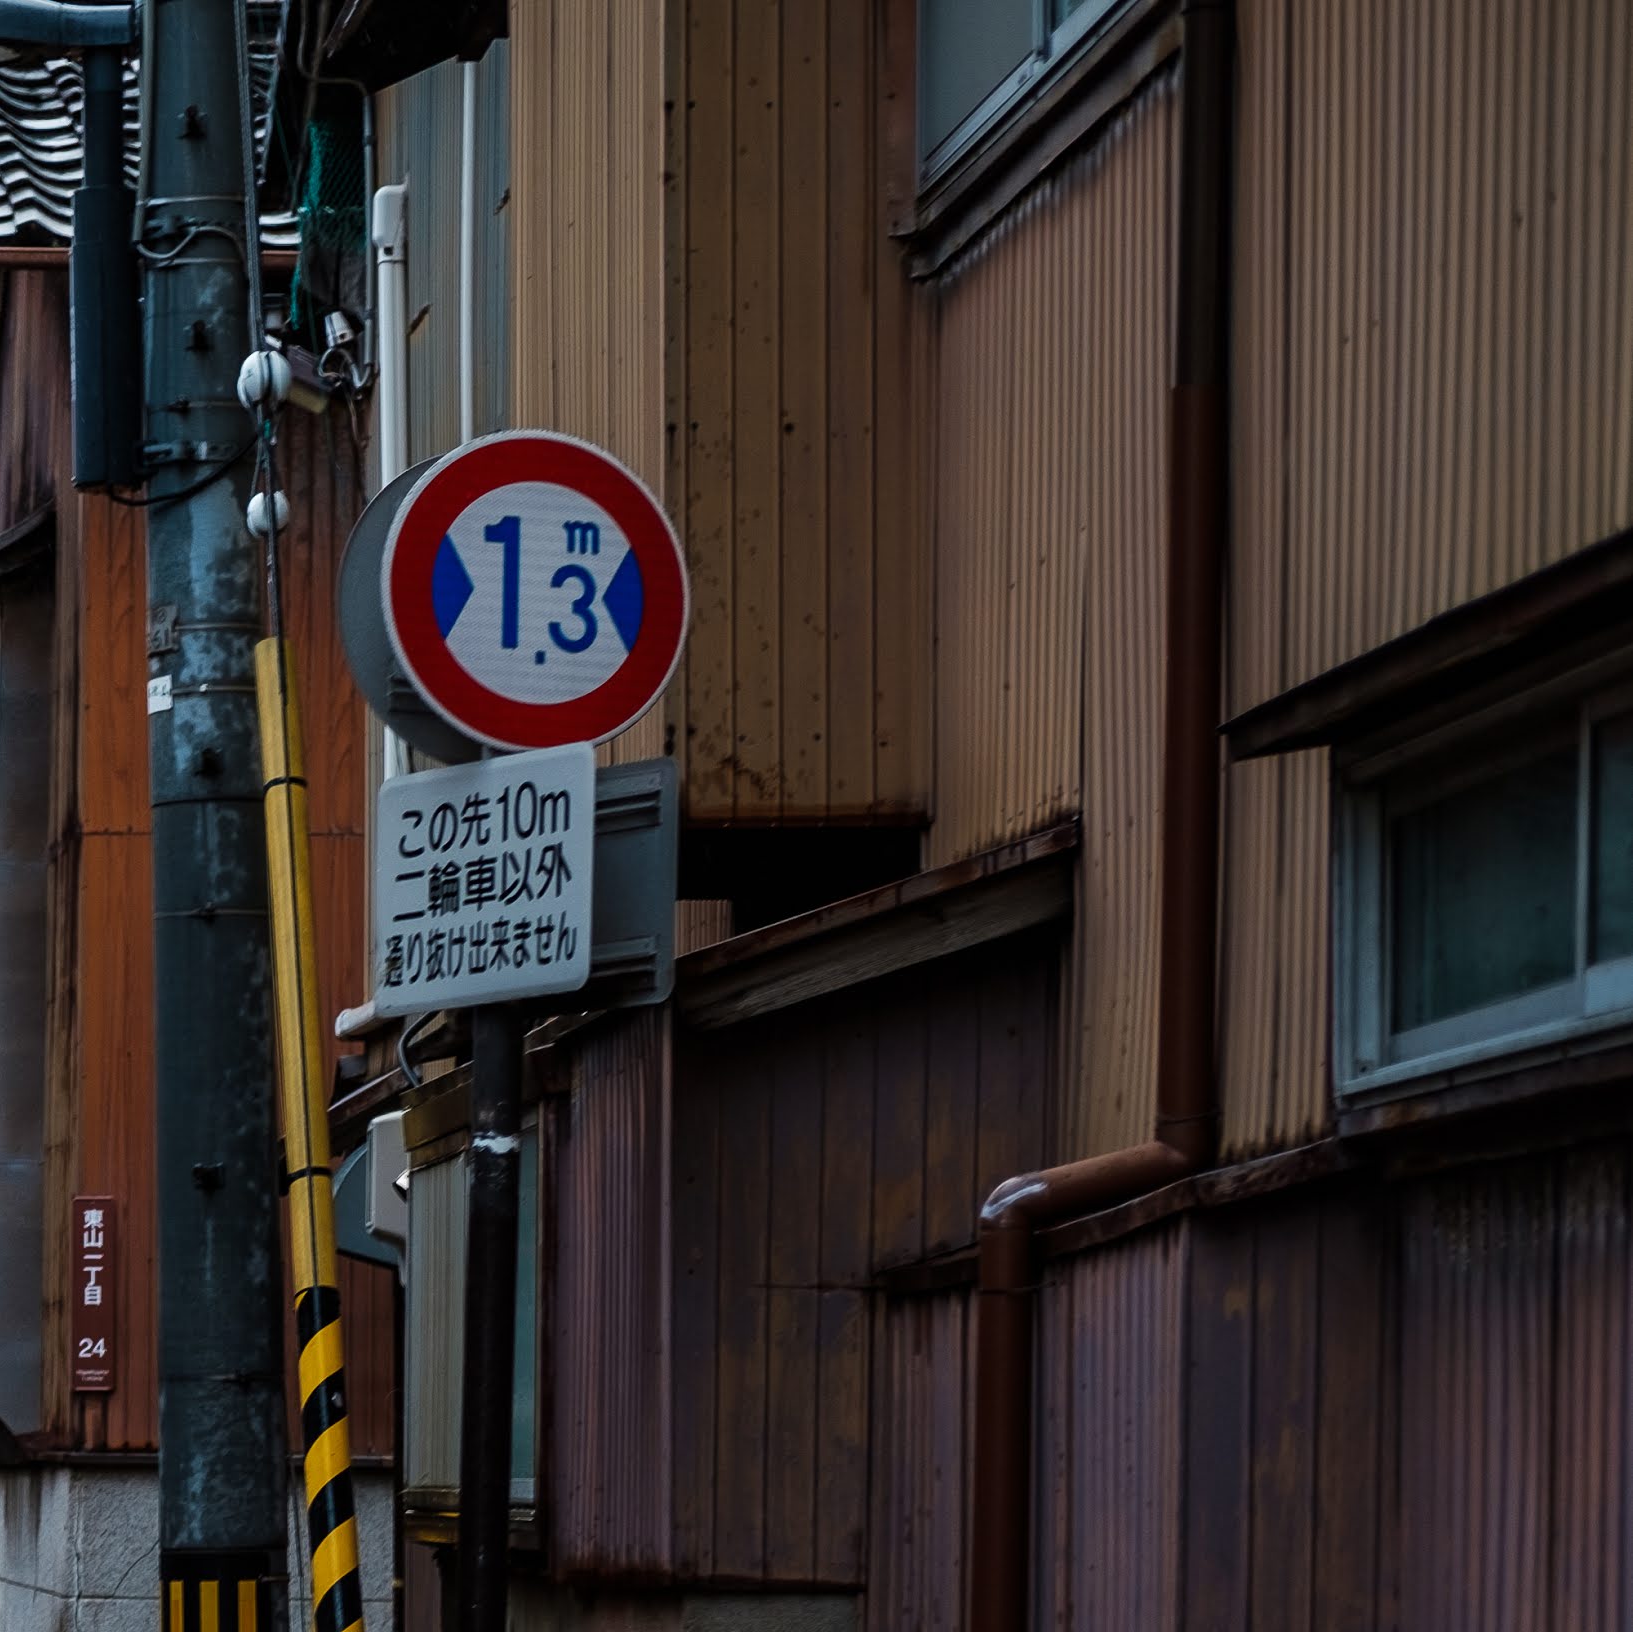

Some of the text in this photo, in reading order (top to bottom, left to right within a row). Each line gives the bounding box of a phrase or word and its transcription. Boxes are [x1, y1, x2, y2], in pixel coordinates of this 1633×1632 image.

[484, 515, 600, 665] 1.3 m
[399, 781, 571, 858] この先10m
[393, 841, 572, 922] 二輪車以外
[83, 1209, 104, 1306] 東山一丁目
[78, 1337, 107, 1358] 24
